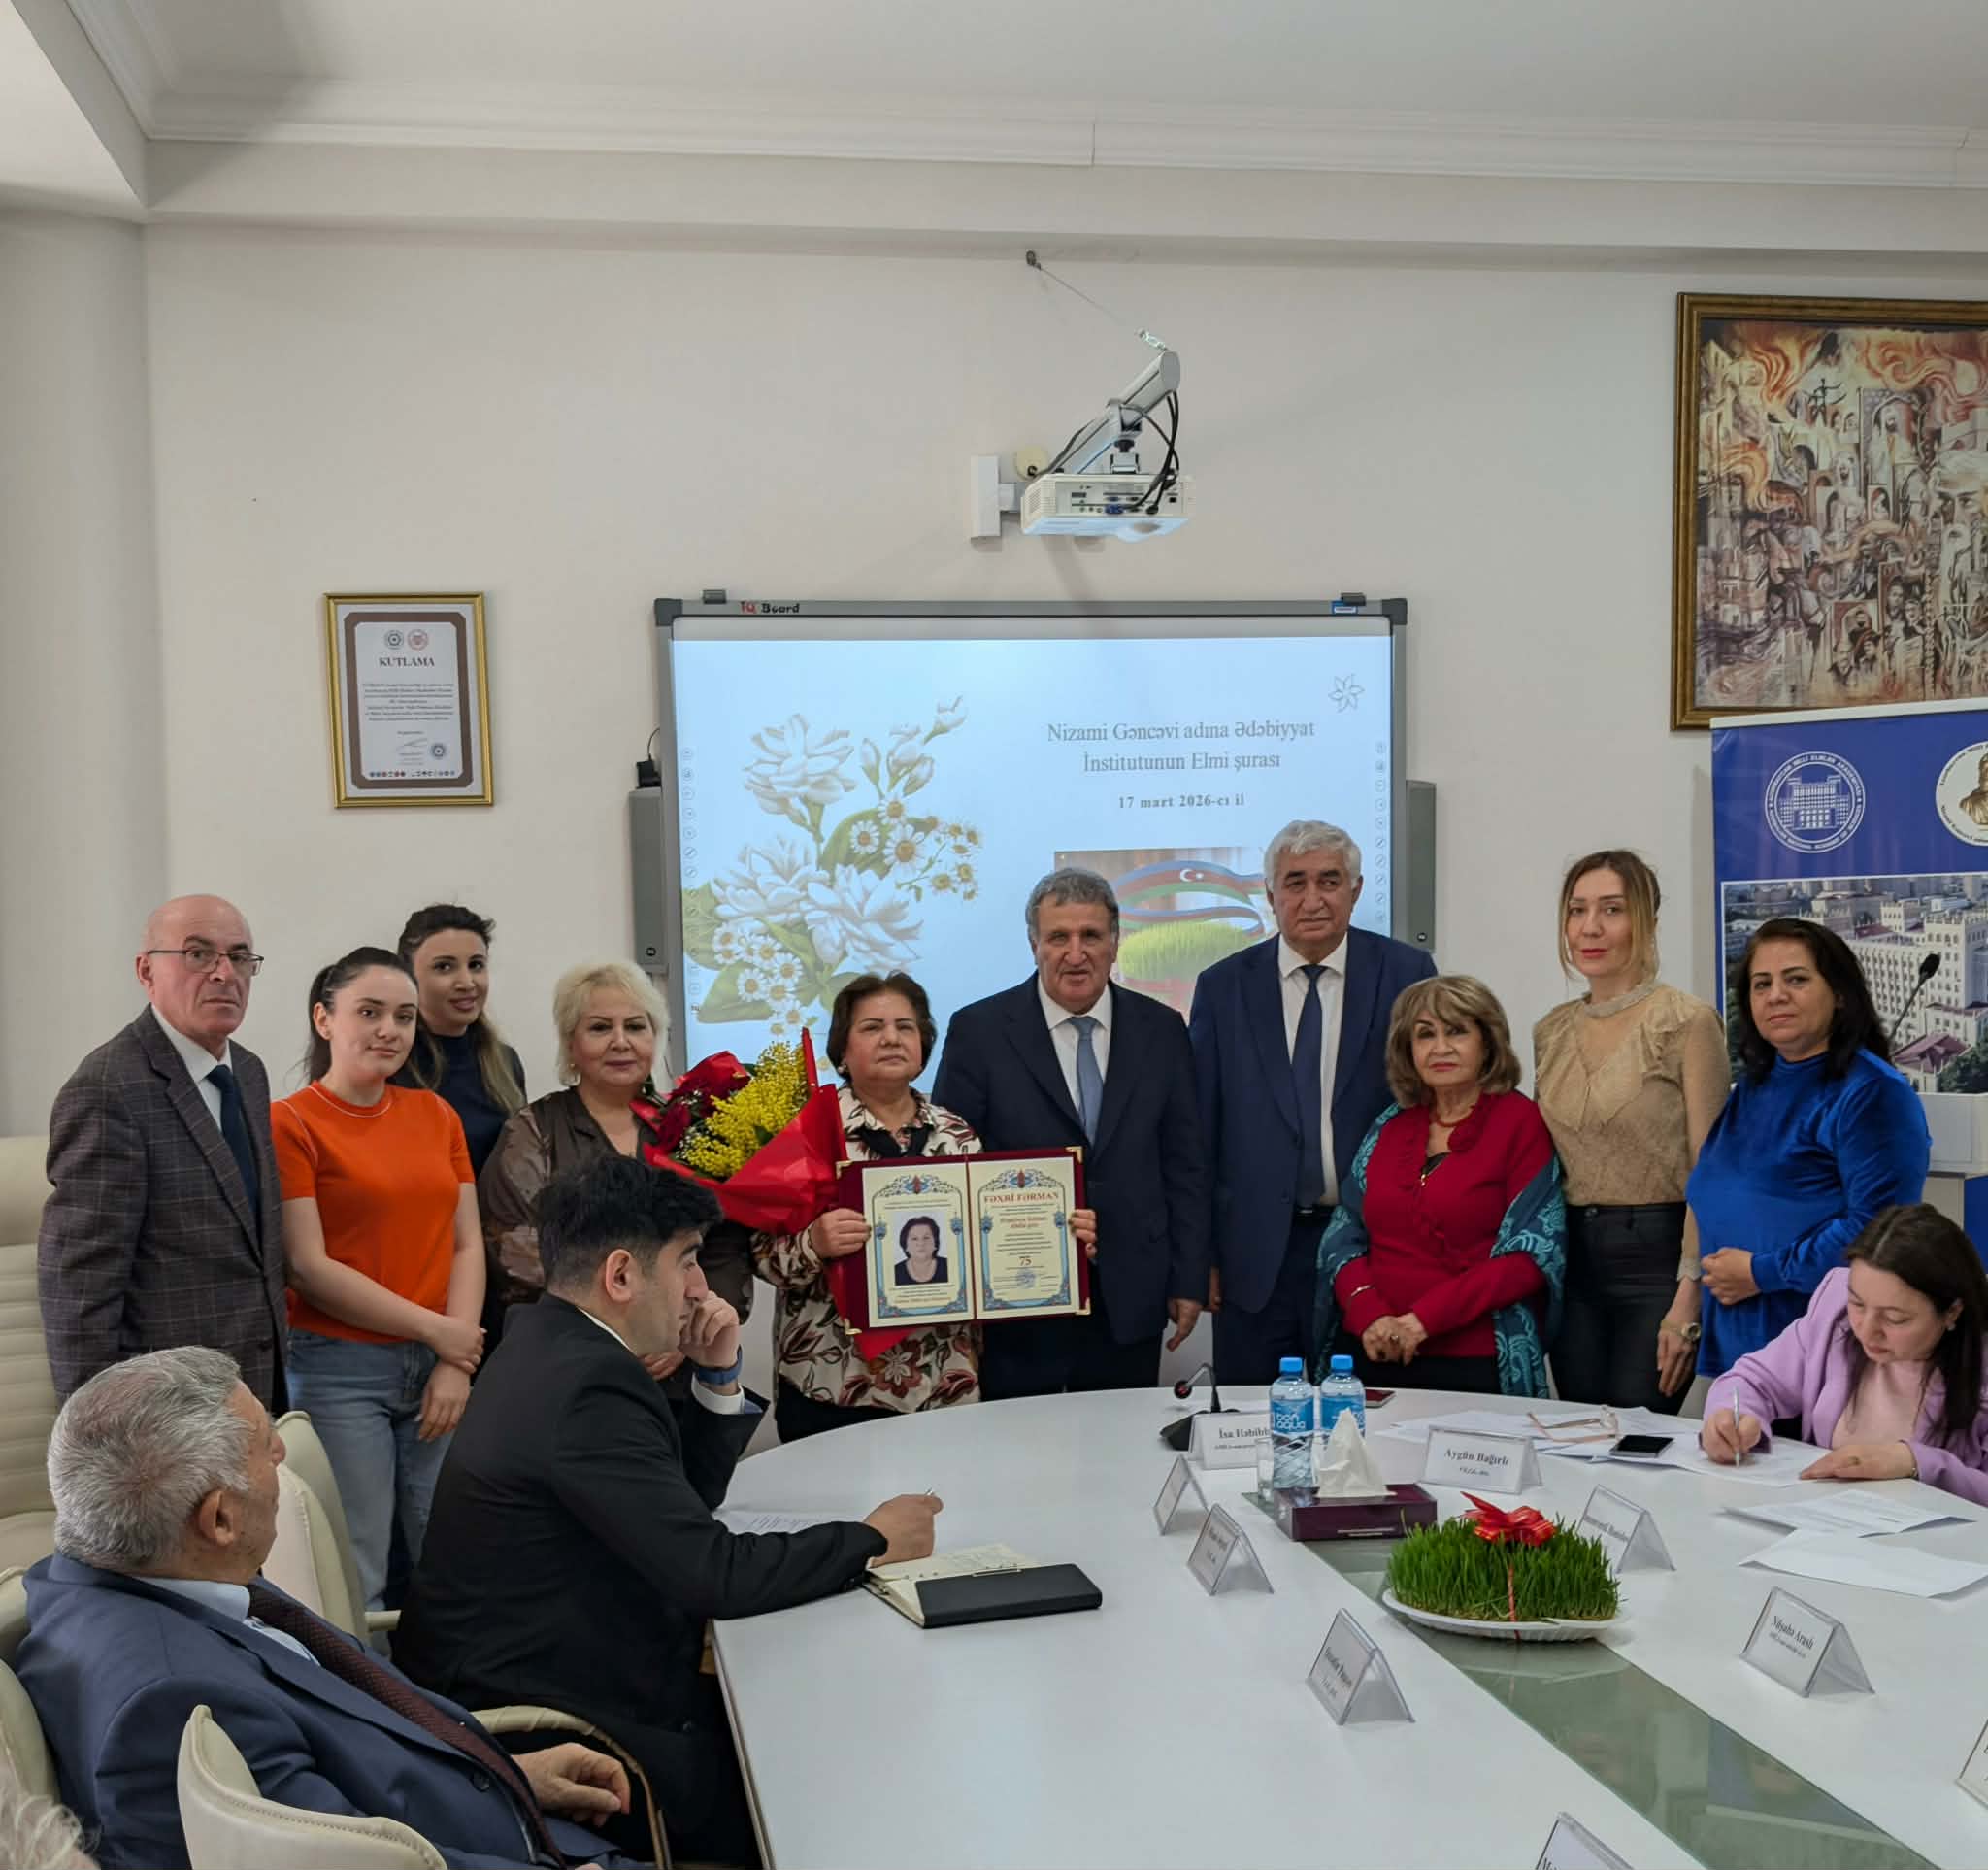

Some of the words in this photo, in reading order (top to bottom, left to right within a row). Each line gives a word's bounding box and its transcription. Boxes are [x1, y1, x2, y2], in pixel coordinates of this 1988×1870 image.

[761, 603, 800, 614] Board
[379, 657, 435, 667] KUTLAMA
[1047, 723, 1108, 742] Nizami
[1112, 722, 1179, 739] Gəncəvi
[1183, 721, 1230, 739] adına
[1234, 720, 1314, 742] Ədəbiyyat
[1083, 751, 1185, 772] İnstitutunun
[1192, 751, 1229, 770] Elmi
[1234, 753, 1281, 772] şurası
[1118, 796, 1134, 809] 17
[1140, 796, 1174, 809] mart
[1179, 794, 1230, 807] 2026-cı
[1234, 792, 1244, 806] il
[1019, 1255, 1032, 1266] 75
[1276, 1420, 1306, 1431] aqua
[1444, 1448, 1474, 1461] Aygün
